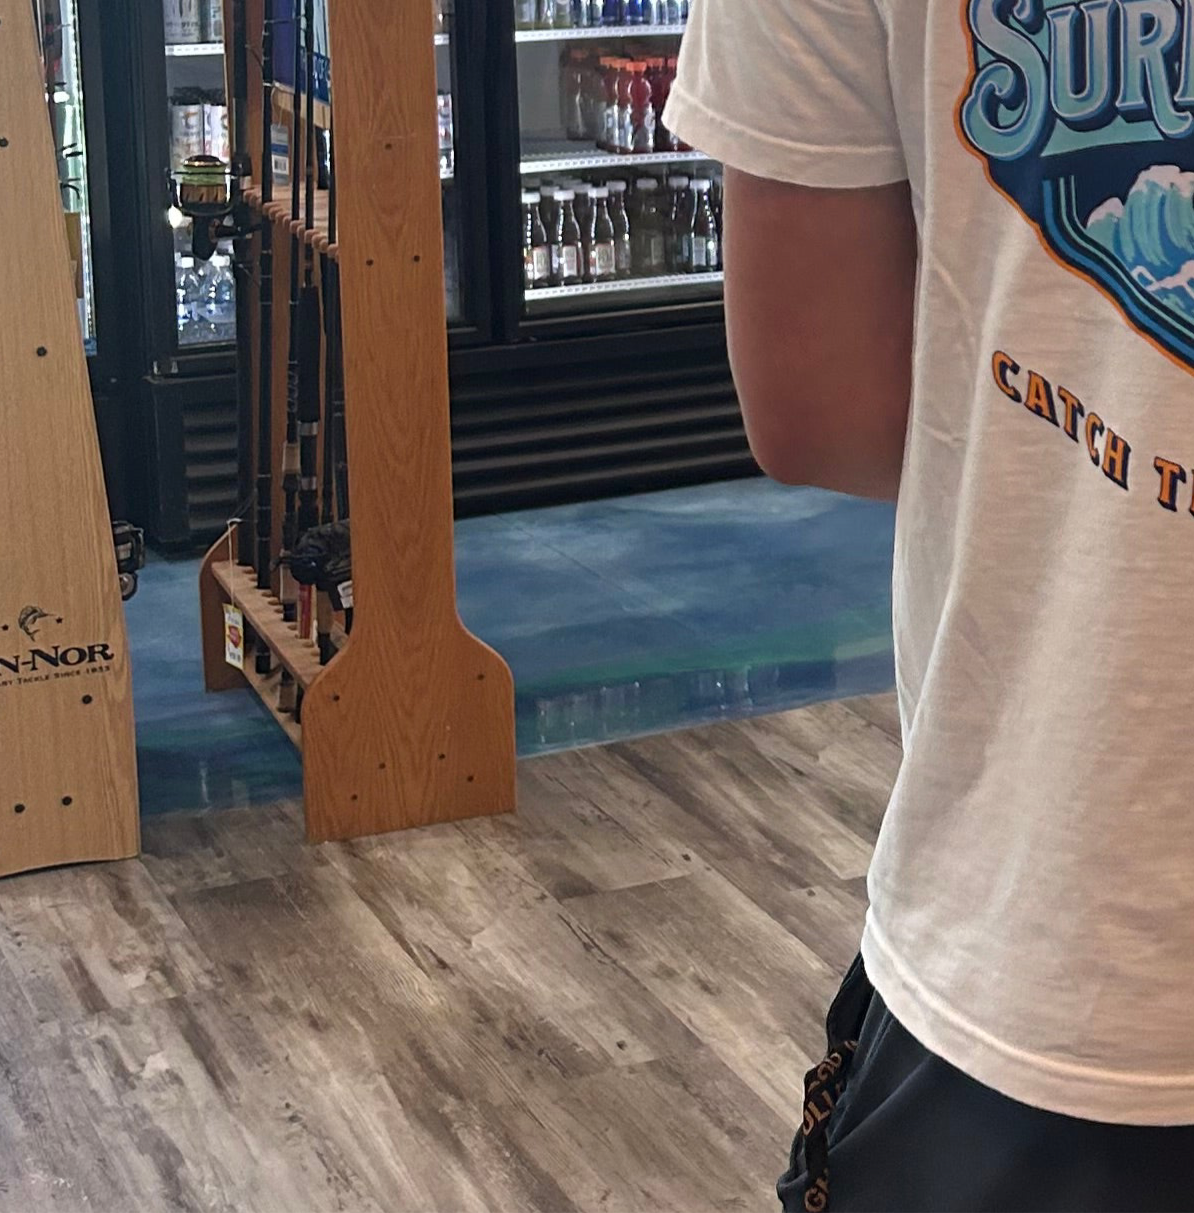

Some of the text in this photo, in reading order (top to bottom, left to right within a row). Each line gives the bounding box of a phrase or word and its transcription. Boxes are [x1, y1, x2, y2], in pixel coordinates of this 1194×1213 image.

[992, 351, 1130, 490] CATCH
[17, 674, 49, 685] TACKLE
[54, 670, 80, 678] SINCE
